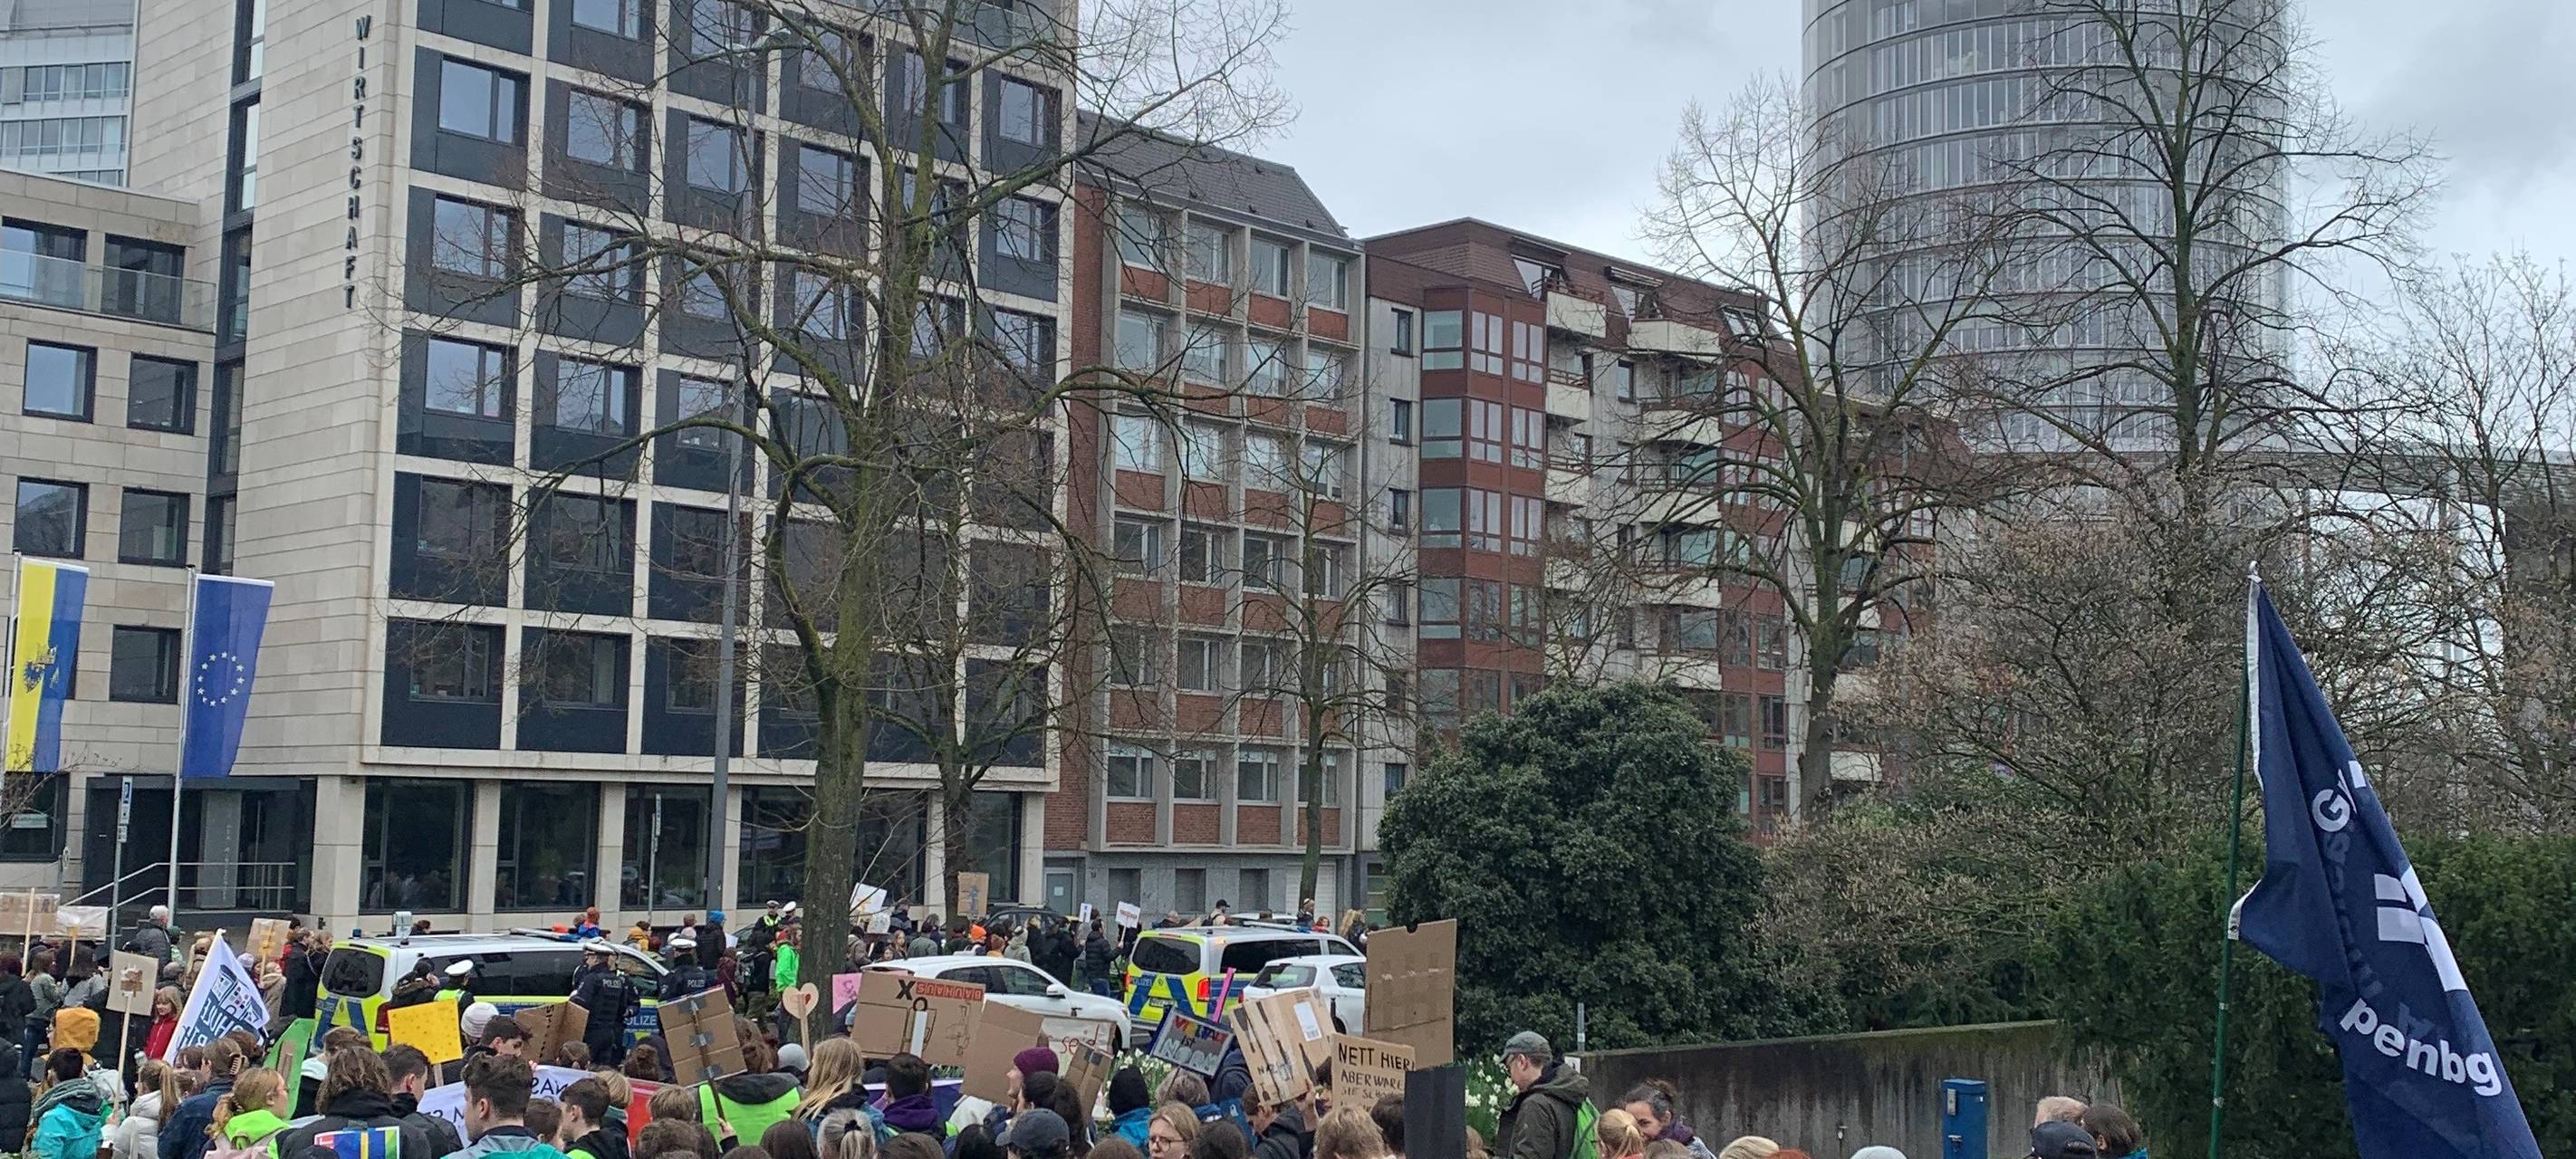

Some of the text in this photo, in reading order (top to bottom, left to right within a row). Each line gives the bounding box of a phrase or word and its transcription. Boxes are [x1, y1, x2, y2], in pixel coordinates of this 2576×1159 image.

[344, 14, 371, 311] WIRTSCHAFT
[917, 982, 984, 1001] BAUHAUS
[1338, 1042, 1375, 1067] NETT
[1341, 1068, 1403, 1091] ABER WARE
